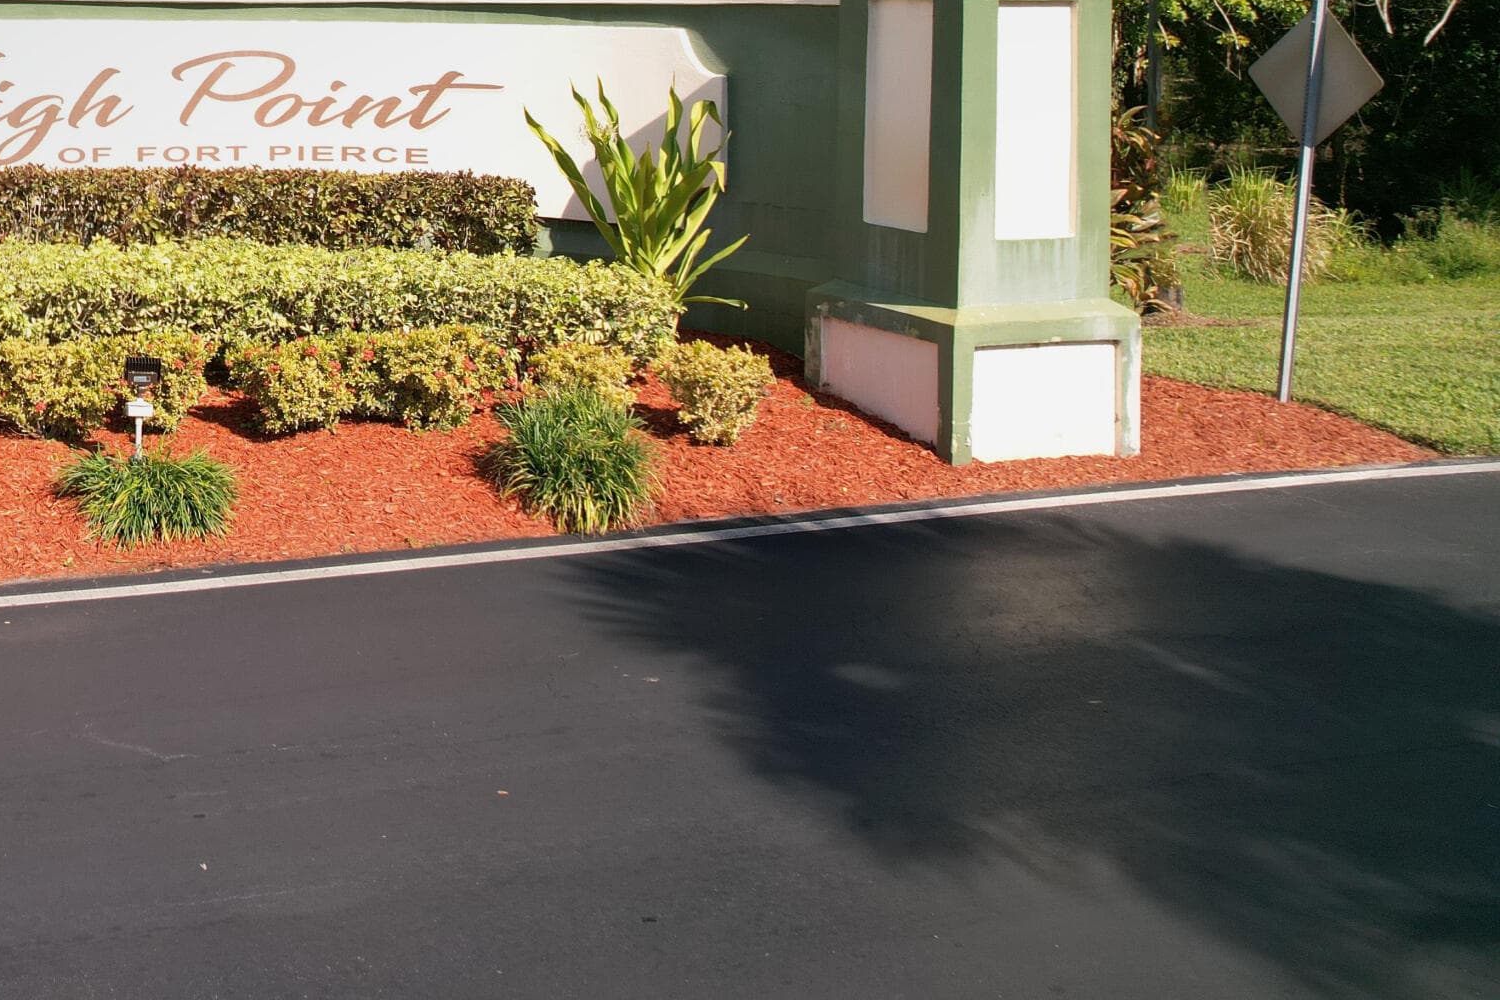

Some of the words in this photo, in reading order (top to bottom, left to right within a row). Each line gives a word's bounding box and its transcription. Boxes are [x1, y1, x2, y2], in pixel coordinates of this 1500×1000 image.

[171, 49, 504, 130] Point
[58, 146, 112, 164] OF
[136, 145, 248, 163] FORT
[268, 145, 430, 165] PIERCE
